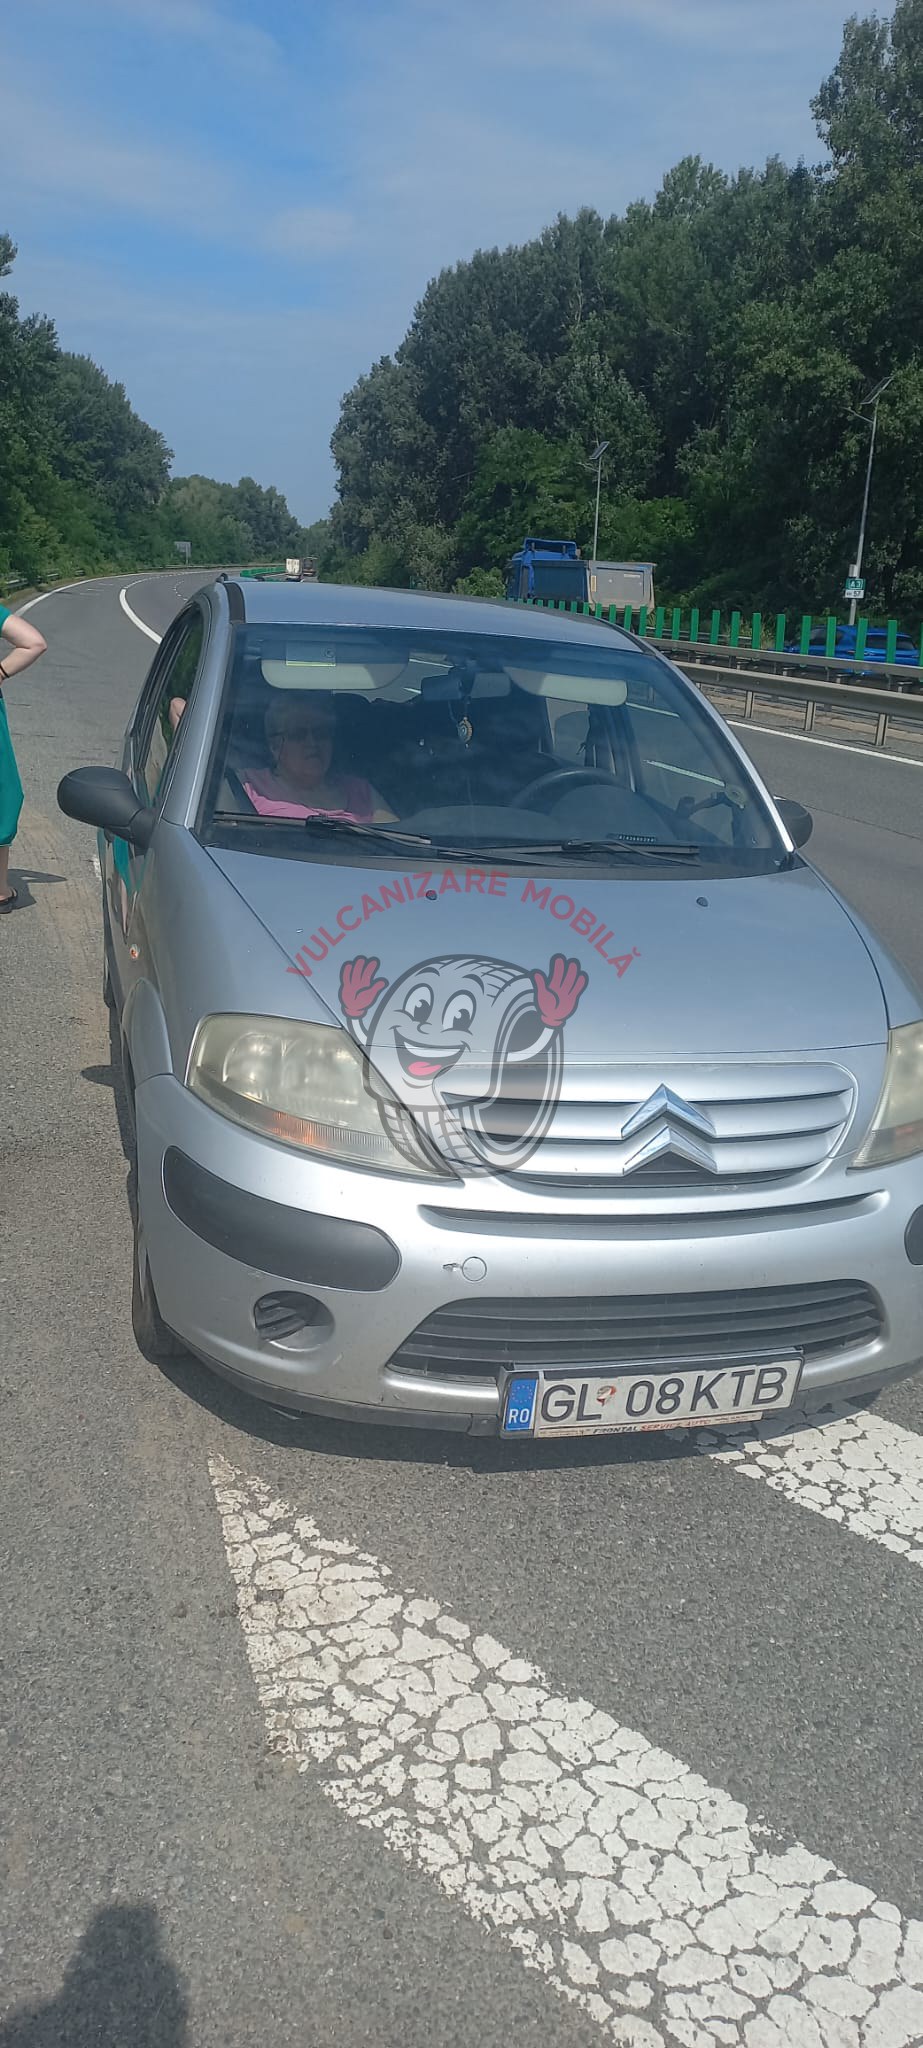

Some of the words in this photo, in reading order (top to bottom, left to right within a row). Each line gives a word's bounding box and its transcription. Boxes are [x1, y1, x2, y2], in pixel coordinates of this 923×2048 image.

[541, 1383, 602, 1422] GL
[626, 1378, 684, 1417] 08
[690, 1367, 788, 1412] KTB
[508, 1407, 530, 1424] RO
[593, 1425, 638, 1434] FRONTAL
